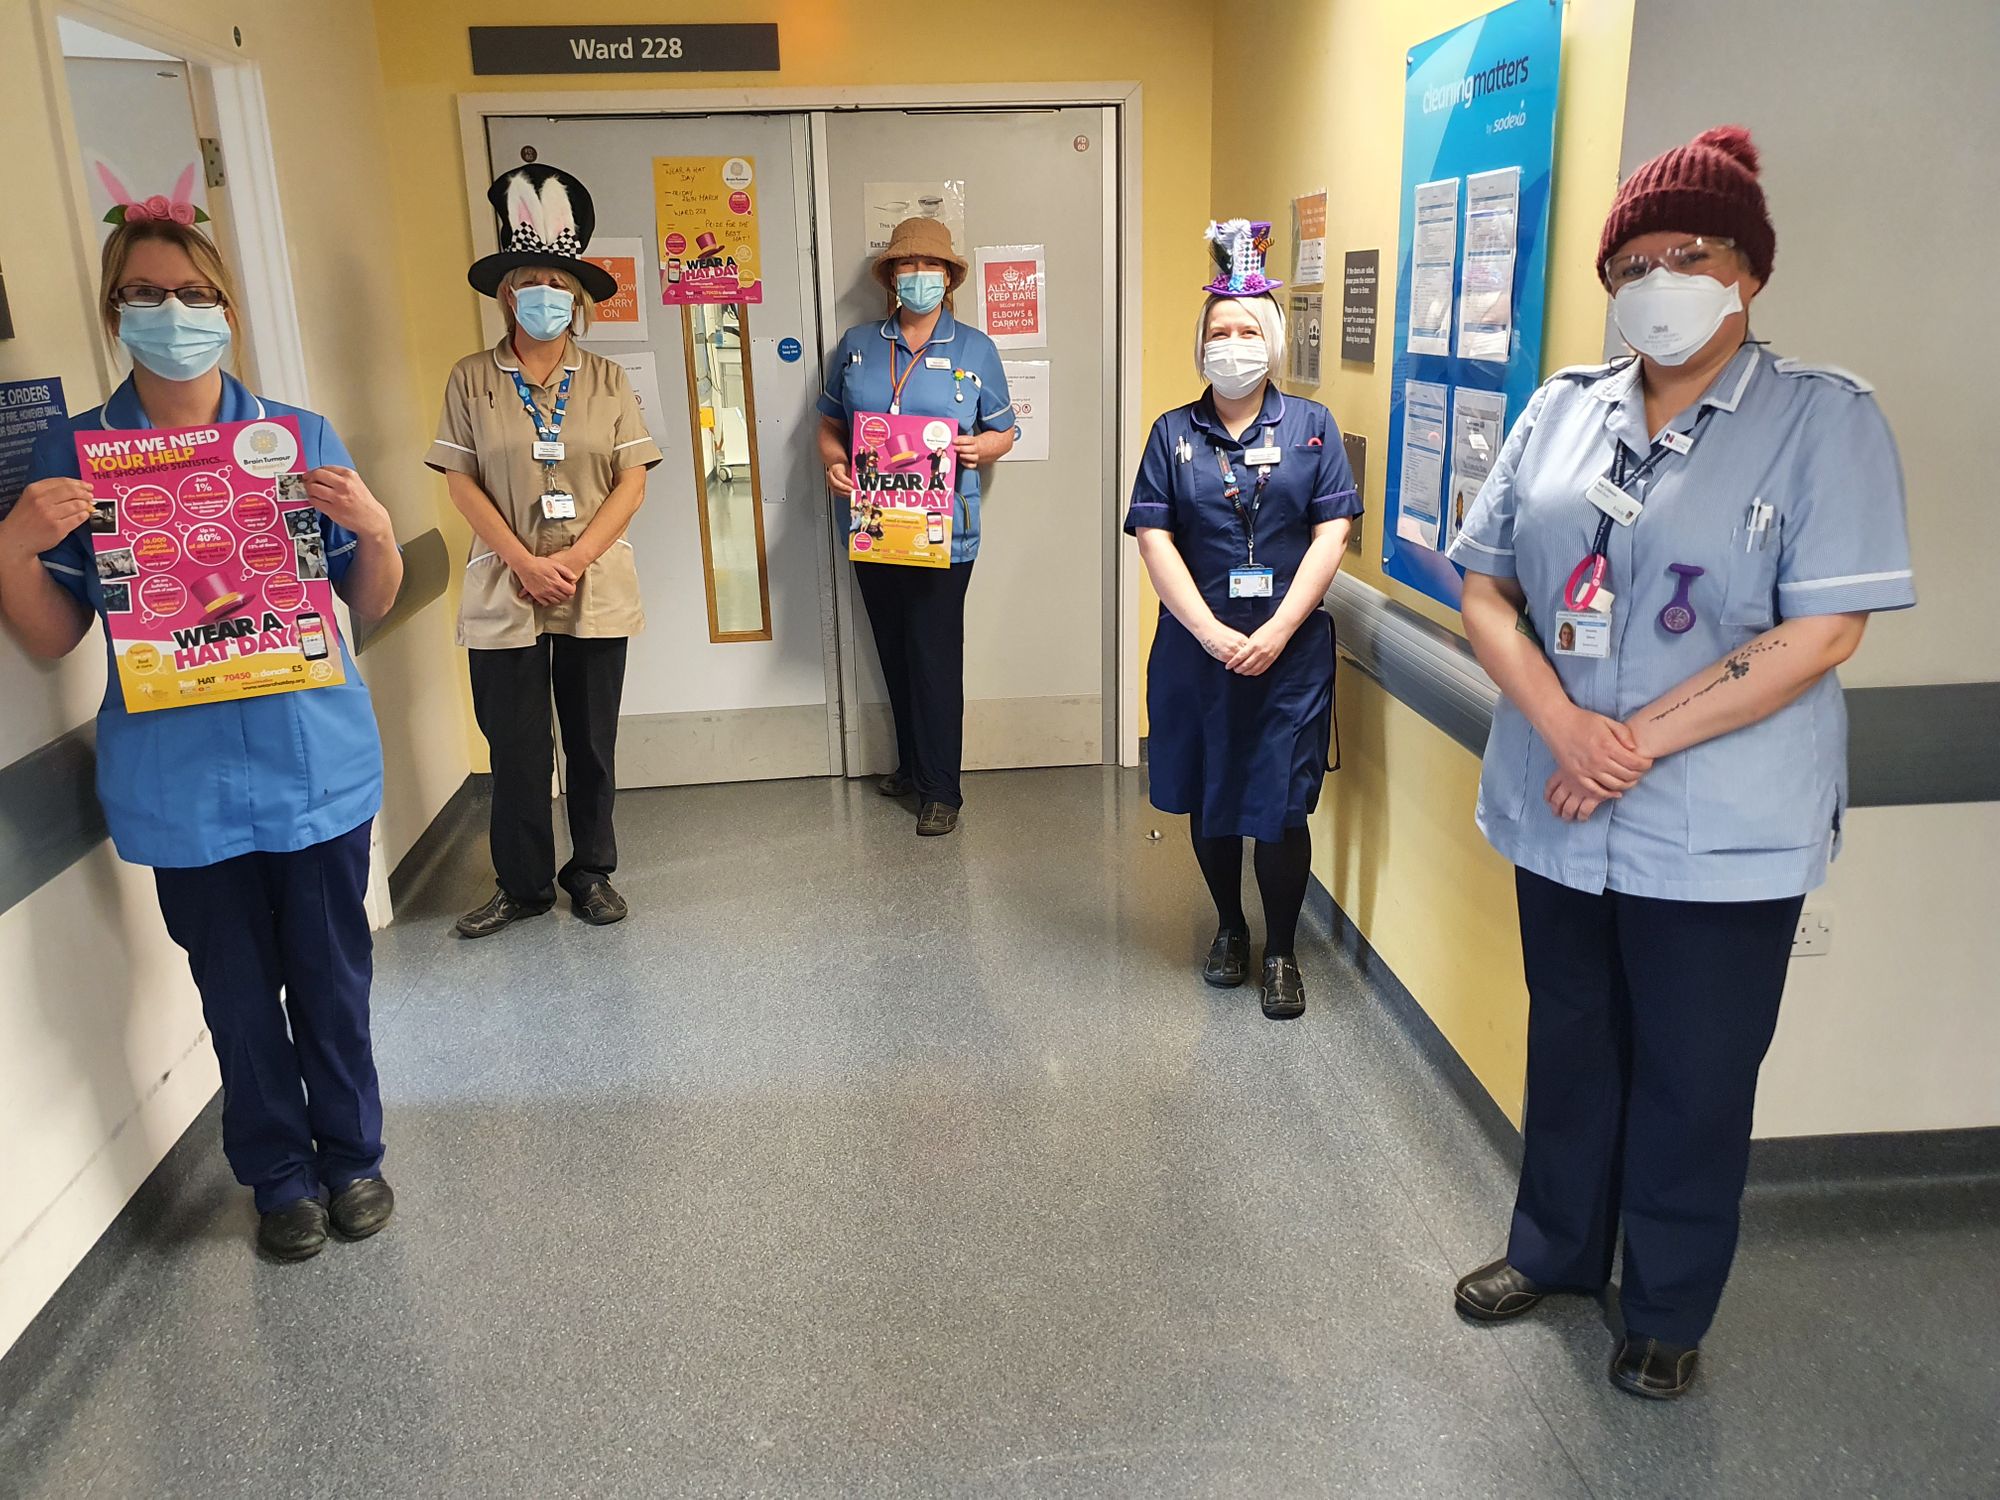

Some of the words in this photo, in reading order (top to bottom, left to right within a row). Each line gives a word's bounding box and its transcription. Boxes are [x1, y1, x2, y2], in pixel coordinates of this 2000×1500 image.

[569, 37, 634, 60] Ward
[641, 37, 682, 59] 228
[1422, 56, 1529, 114] cleaningmatters
[665, 167, 685, 175] WEAR
[681, 174, 696, 182] DAY
[686, 257, 723, 270] WEAR
[726, 256, 737, 266] A
[686, 268, 711, 281] HAT
[714, 264, 738, 277] DAY
[987, 283, 1006, 292] ALL
[600, 298, 634, 308] CARRY
[987, 292, 1010, 302] KEEP
[1012, 291, 1037, 300] BARE
[602, 308, 620, 318] ON
[992, 310, 1026, 319] ELBOWS
[1027, 309, 1033, 317] &
[992, 319, 1018, 328] CARRY
[1021, 318, 1034, 326] ON
[8, 385, 51, 405] ORDERS
[20, 407, 45, 419] HOWEVER
[6, 423, 37, 436] SUSPECTED
[37, 419, 49, 430] FIRE
[84, 440, 132, 458] WHY
[134, 436, 167, 453] WE
[170, 429, 220, 449] NEED
[87, 453, 146, 473] YOUR
[150, 446, 196, 468] HELP
[243, 458, 264, 466] Brain
[263, 455, 291, 463] Tumour
[92, 471, 112, 480] THE
[113, 464, 169, 478] SHOCKING
[194, 483, 213, 492] 1%
[858, 473, 923, 491] WEAR
[928, 474, 946, 491] A
[855, 489, 898, 508] HAT
[905, 489, 949, 508] DAY
[143, 536, 167, 545] 16,000
[196, 533, 222, 542] 40%
[173, 616, 256, 649] WEAR
[262, 611, 285, 633] A
[173, 639, 231, 671] HAT
[238, 625, 291, 657] DAY
[198, 676, 216, 685] HAT
[223, 672, 252, 683] 70450
[260, 668, 290, 678] donate
[292, 664, 303, 673] £5
